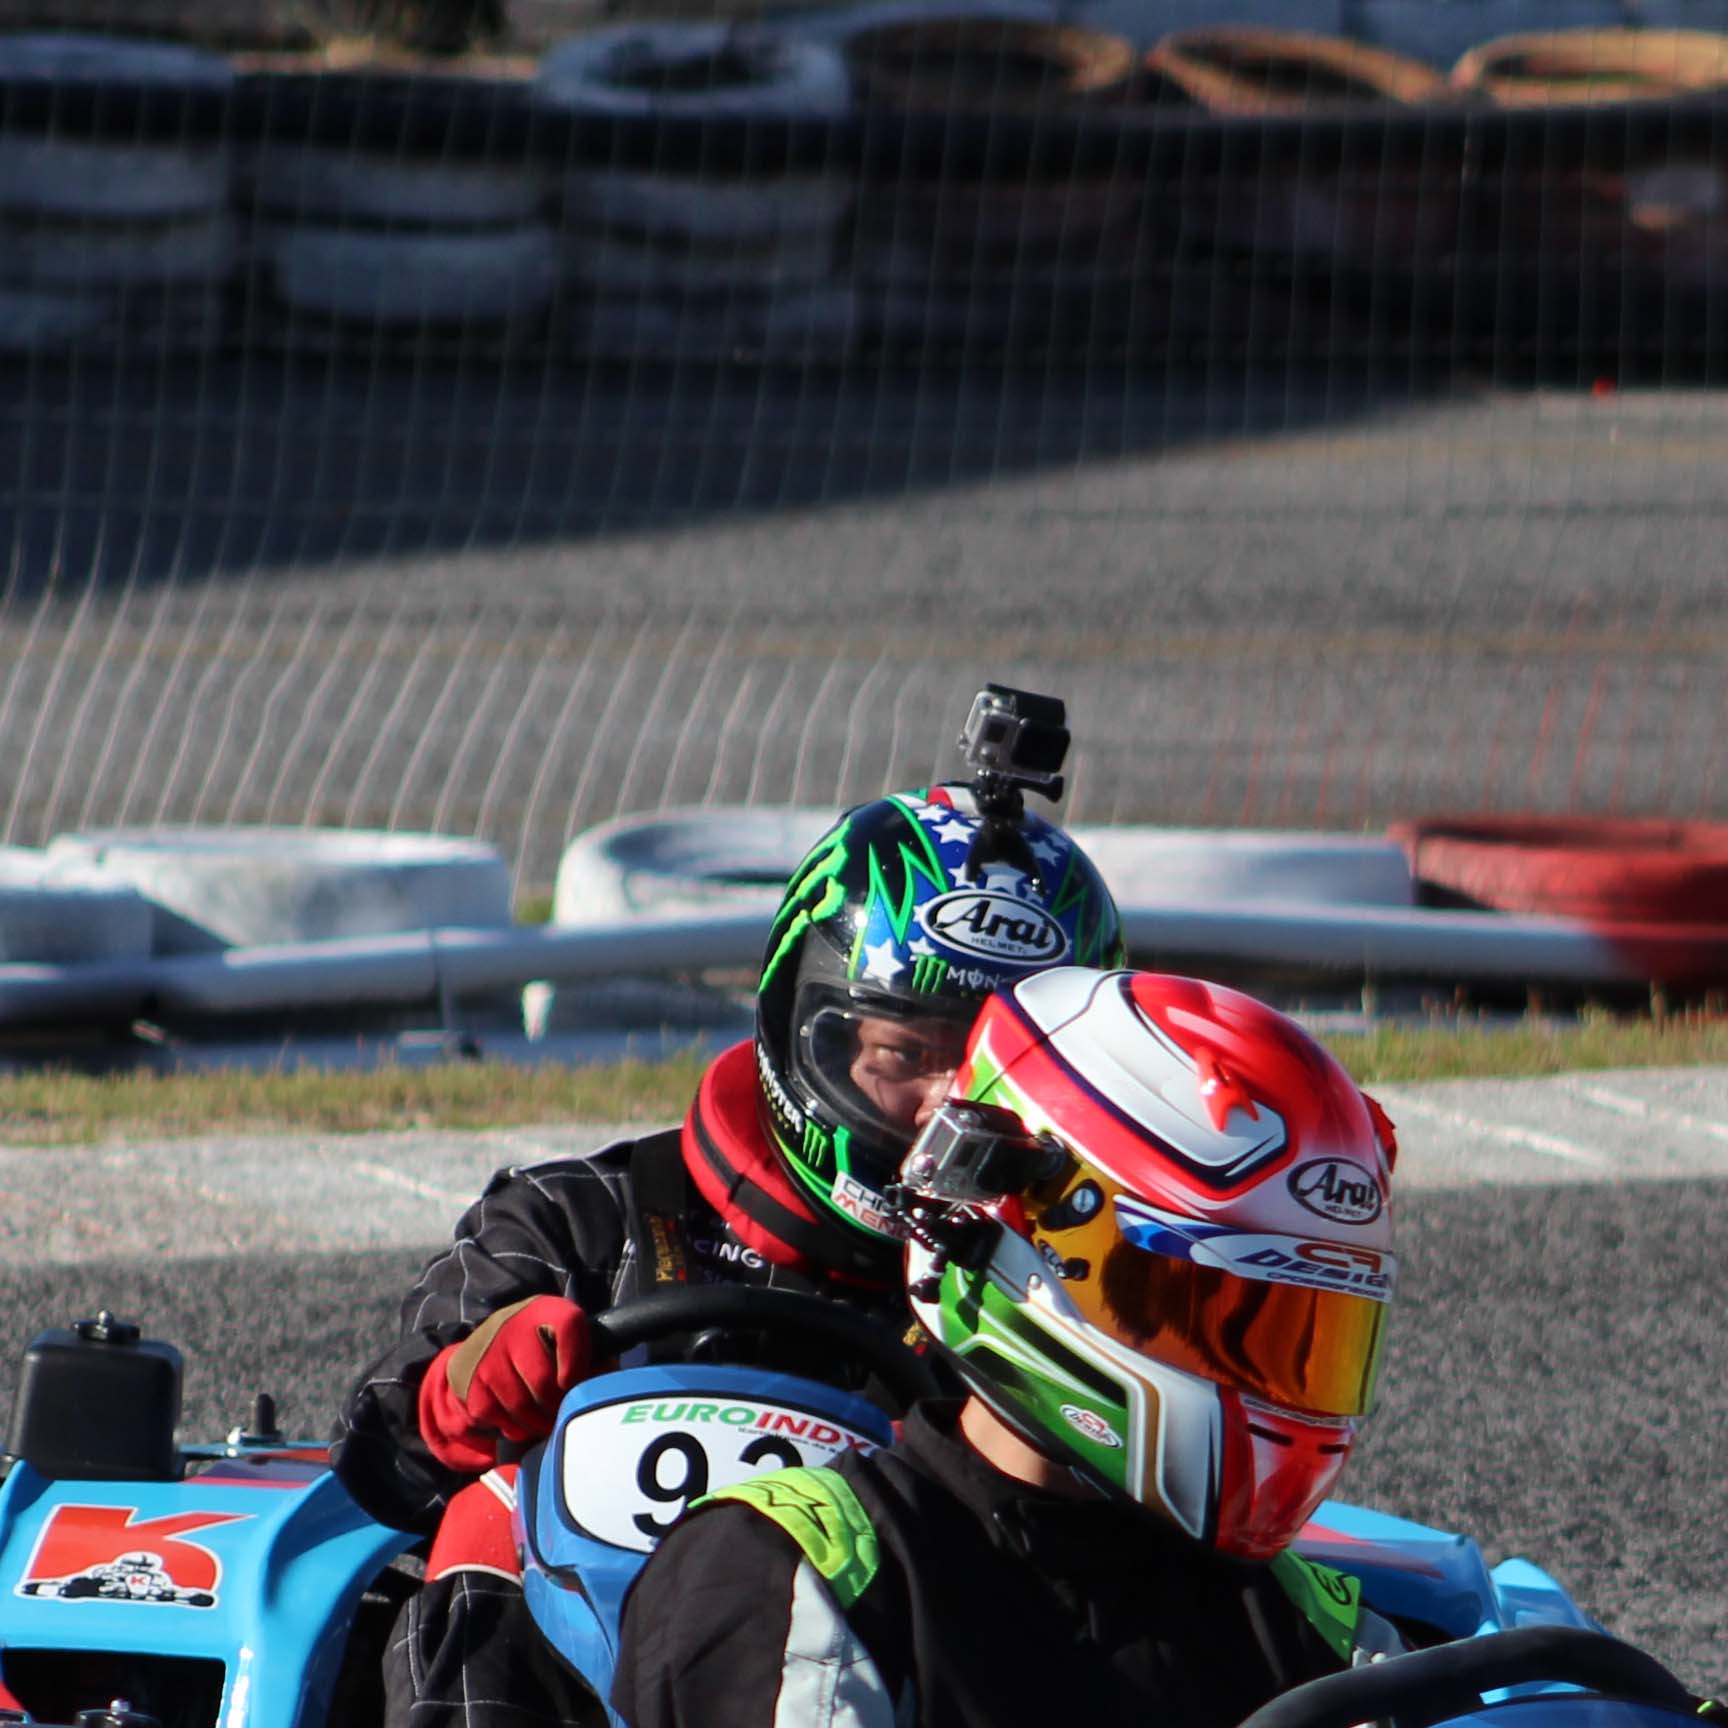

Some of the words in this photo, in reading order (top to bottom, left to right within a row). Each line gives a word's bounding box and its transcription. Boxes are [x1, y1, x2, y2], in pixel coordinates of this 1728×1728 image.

[934, 899, 1052, 949] Arai
[1296, 1163, 1374, 1210] Arai
[621, 1403, 873, 1451] EUROINDY
